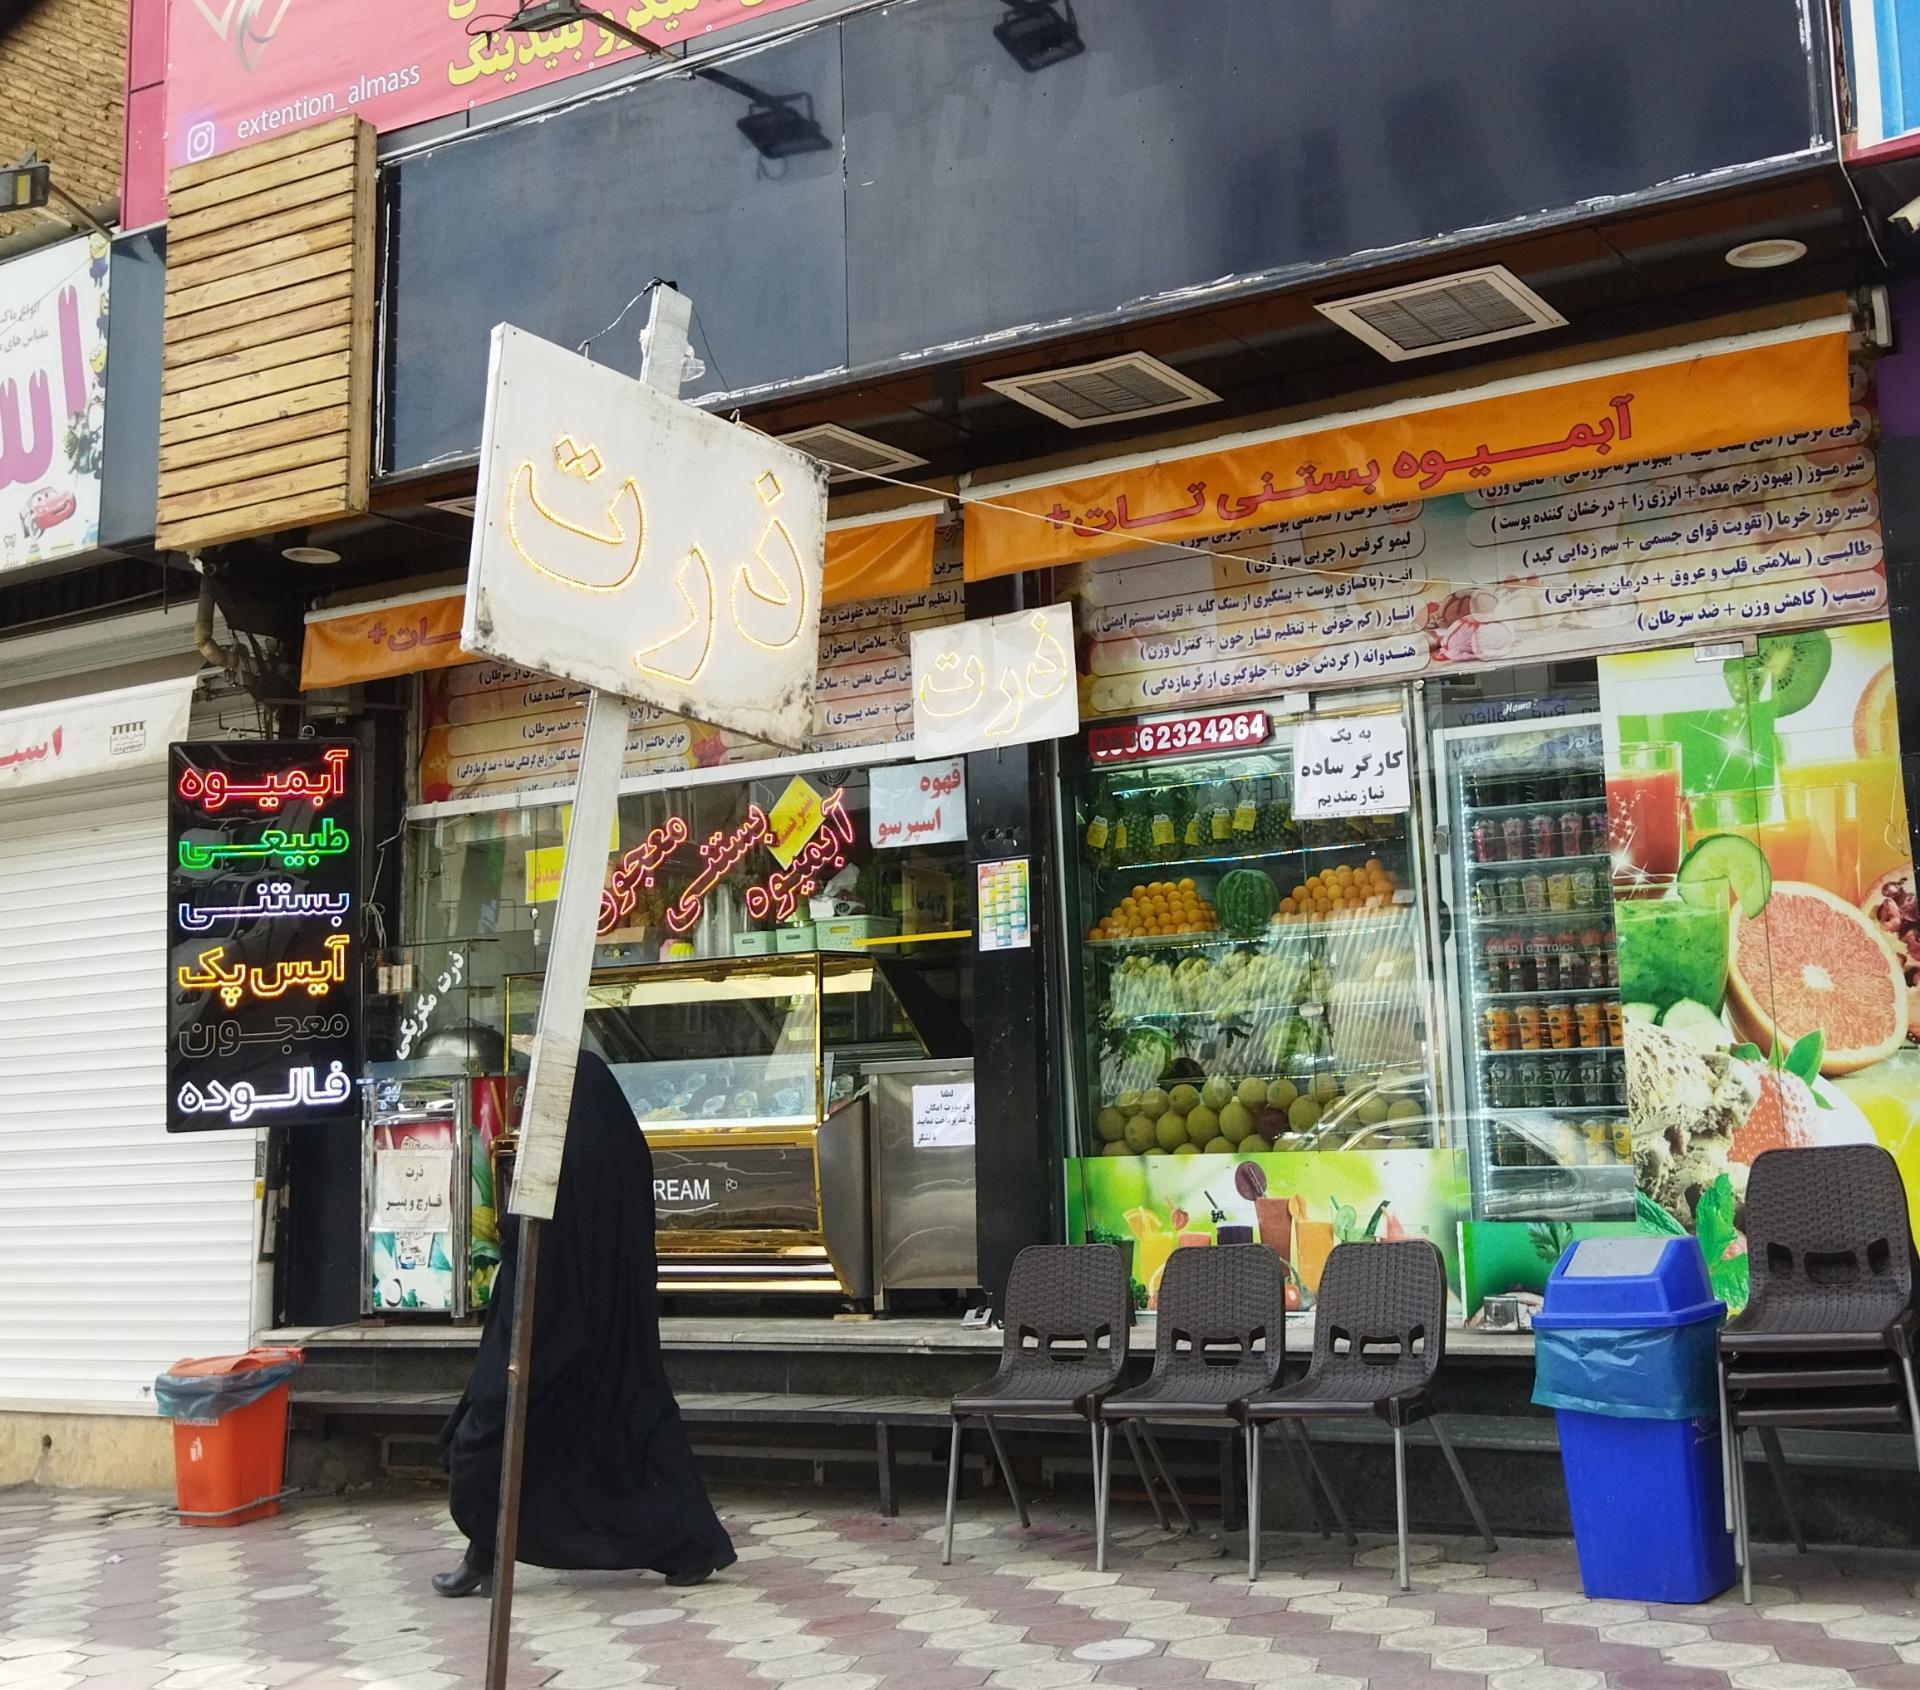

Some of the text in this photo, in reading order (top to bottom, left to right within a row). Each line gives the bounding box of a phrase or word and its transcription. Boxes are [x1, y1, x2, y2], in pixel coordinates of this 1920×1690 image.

[237, 64, 420, 139] extention_almass
[1393, 394, 1634, 490] آبمیوه
[1807, 465, 1839, 484] موز
[1843, 453, 1865, 476] شیر
[1216, 457, 1381, 521] بستنی
[1699, 484, 1730, 497] معده
[1732, 475, 1760, 494] زخم
[1761, 470, 1793, 489] بهبود
[1647, 484, 1682, 509] انرژی
[1533, 506, 1563, 524] کننده
[1567, 500, 1615, 522] درخشان
[1777, 505, 1811, 530] خرما
[1815, 506, 1840, 526] موز
[1844, 496, 1869, 521] شیر
[1499, 513, 1531, 531] پوست
[1685, 520, 1719, 545] قوای
[1722, 514, 1762, 537] تقویت
[1349, 535, 1384, 559] کرفس
[1388, 530, 1411, 549] لیمو
[1639, 529, 1683, 551] جسمی
[506, 433, 810, 685] ذرت
[1304, 546, 1337, 566] چربی
[1532, 546, 1555, 564] کبد
[1751, 548, 1802, 576] سلامتی
[1817, 540, 1873, 567] طالبی
[1669, 566, 1706, 589] عروق
[1710, 568, 1718, 581] و
[1722, 555, 1748, 577] قلب
[928, 591, 951, 610] تنظیم
[1242, 593, 1251, 611] از
[1252, 588, 1292, 609] پیشگیری
[1306, 584, 1333, 601] پوست
[892, 594, 927, 616] کلسترول
[1196, 600, 1215, 617] کلیه
[1385, 605, 1415, 628] انار
[1647, 587, 1876, 632] سیب کاهش وزن ضد سرطان
[1321, 618, 1354, 636] خونی
[1356, 612, 1371, 631] کم
[1218, 633, 1244, 649] خون
[1248, 625, 1271, 646] فشار
[1147, 644, 1170, 661] وزن
[919, 610, 1069, 738] ذرت
[1150, 644, 1416, 697] هندوانه گردش خون جلوگیری از گرمازدگی
[833, 708, 862, 725] پیری
[1330, 727, 1373, 743] به یک
[1300, 749, 1404, 779] کارگر ساده
[179, 748, 349, 810] آبمیوه
[920, 765, 962, 799] قهوه
[1317, 785, 1385, 809] نیازمندیم
[178, 818, 350, 869] طبیعی
[745, 787, 854, 920] آبمیوه
[666, 803, 775, 932] بستنی
[178, 882, 350, 931] بستنی
[178, 934, 350, 1008] آیس پک
[437, 950, 464, 993] ذرت
[179, 1012, 350, 1059] معجون
[177, 1060, 352, 1123] فالوده
[405, 1165, 424, 1182] ذرت
